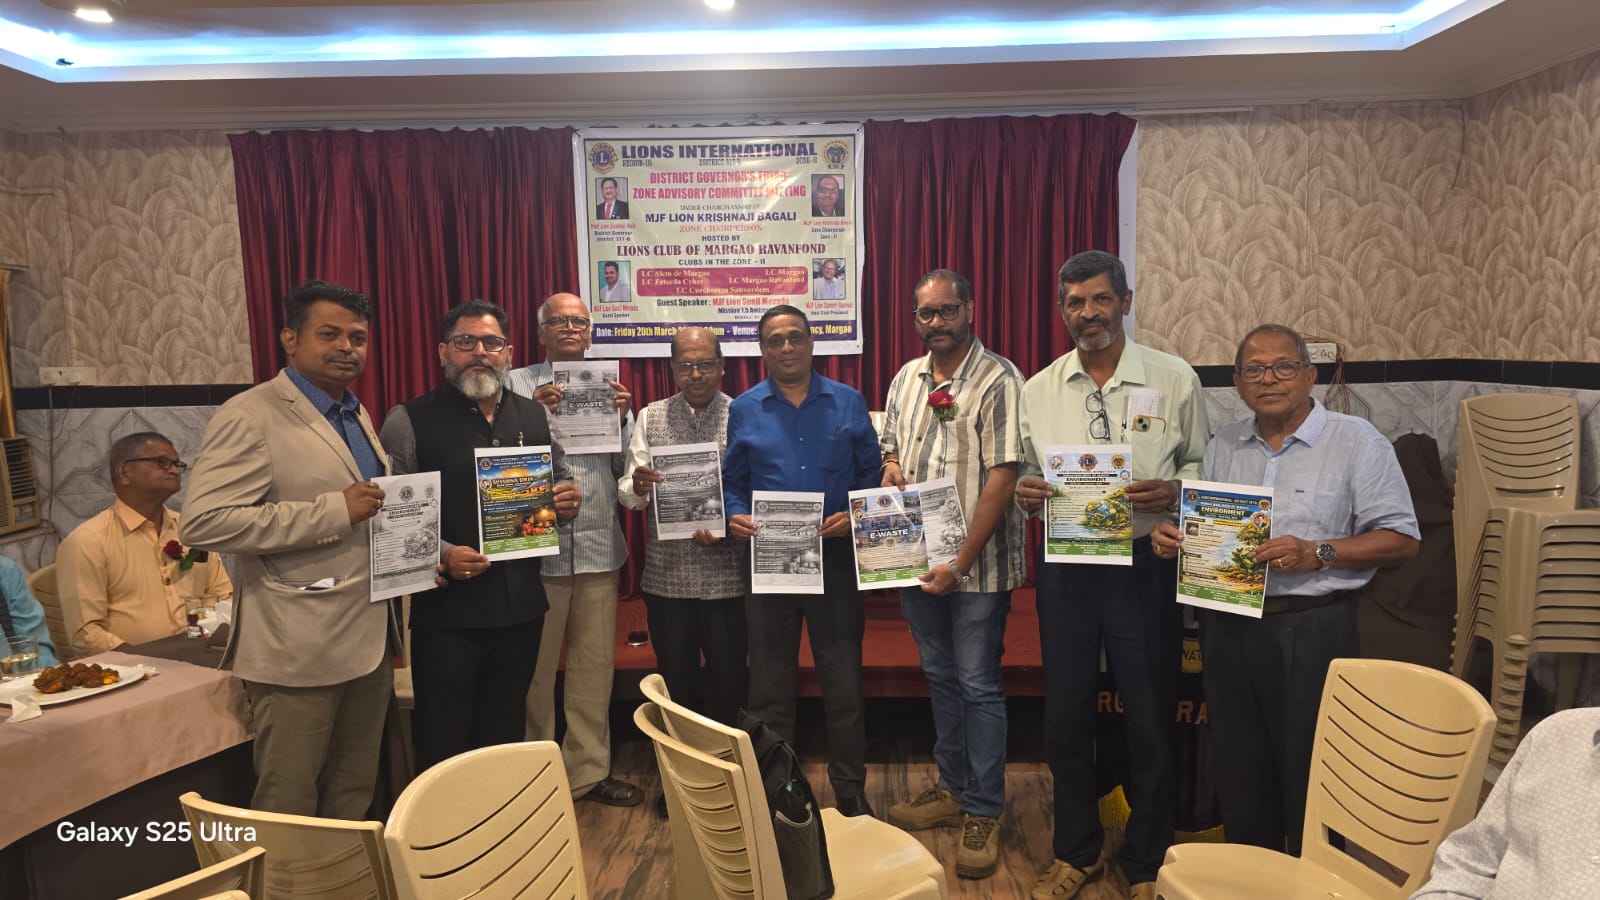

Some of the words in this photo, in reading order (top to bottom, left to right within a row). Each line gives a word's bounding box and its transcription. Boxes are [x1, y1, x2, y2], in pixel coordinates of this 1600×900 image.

[622, 145, 674, 158] LIONS
[679, 142, 817, 158] INTERNATIONAL
[650, 172, 694, 184] DISTRICT
[697, 171, 756, 183] GOVERNOR'S
[633, 188, 656, 199] ZONE
[658, 188, 706, 199] ADVISORY
[709, 186, 762, 198] COMMITTEE
[765, 185, 806, 197] MEETING
[645, 213, 666, 222] MJF
[669, 213, 695, 222] LION
[697, 212, 754, 222] KRISHNAJI
[757, 212, 797, 221] BAGALI
[680, 225, 701, 233] ZONE
[704, 224, 763, 232] CHAIRPERSON
[617, 246, 649, 257] LIONS
[654, 245, 681, 256] CLUB
[686, 245, 701, 255] OF
[705, 244, 755, 256] MARGAO
[758, 243, 826, 255] RAVANFOND
[683, 270, 711, 278] Margao
[778, 269, 805, 277] Margao
[657, 299, 677, 307] Guest
[679, 299, 708, 307] Speaker
[713, 297, 726, 306] MJF
[727, 297, 741, 305] Lion
[743, 297, 761, 305] Sunil
[718, 307, 740, 315] Mission
[596, 327, 613, 337] Date:
[614, 327, 636, 337] Friday
[637, 326, 653, 336] 20th
[654, 326, 677, 336] March
[732, 326, 758, 335] Venue:
[825, 325, 852, 335] Margao
[1201, 507, 1245, 516] ENVIRONMENT
[870, 529, 909, 539] E-WASTE
